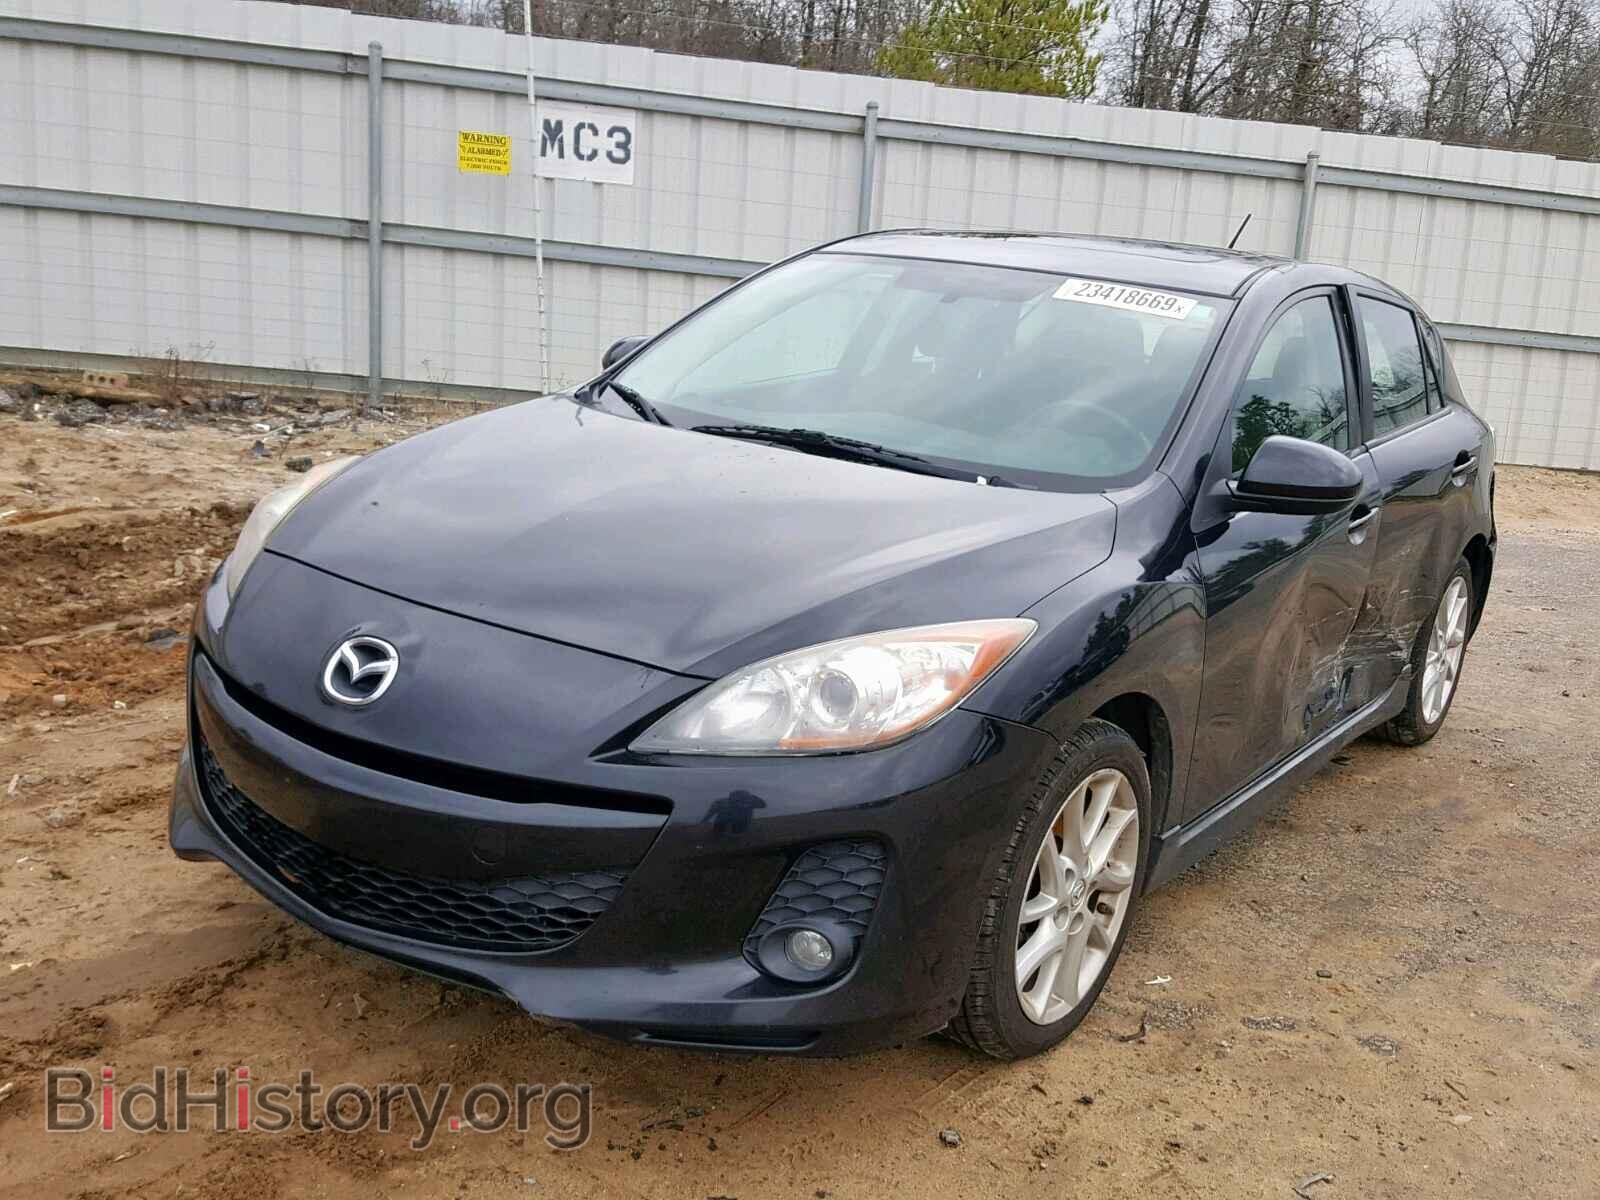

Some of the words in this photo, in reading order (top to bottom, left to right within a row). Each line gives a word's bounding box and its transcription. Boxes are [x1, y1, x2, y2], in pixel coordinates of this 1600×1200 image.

[462, 132, 507, 146] WARNING
[540, 118, 632, 165] MC3
[467, 147, 501, 157] ALARMED
